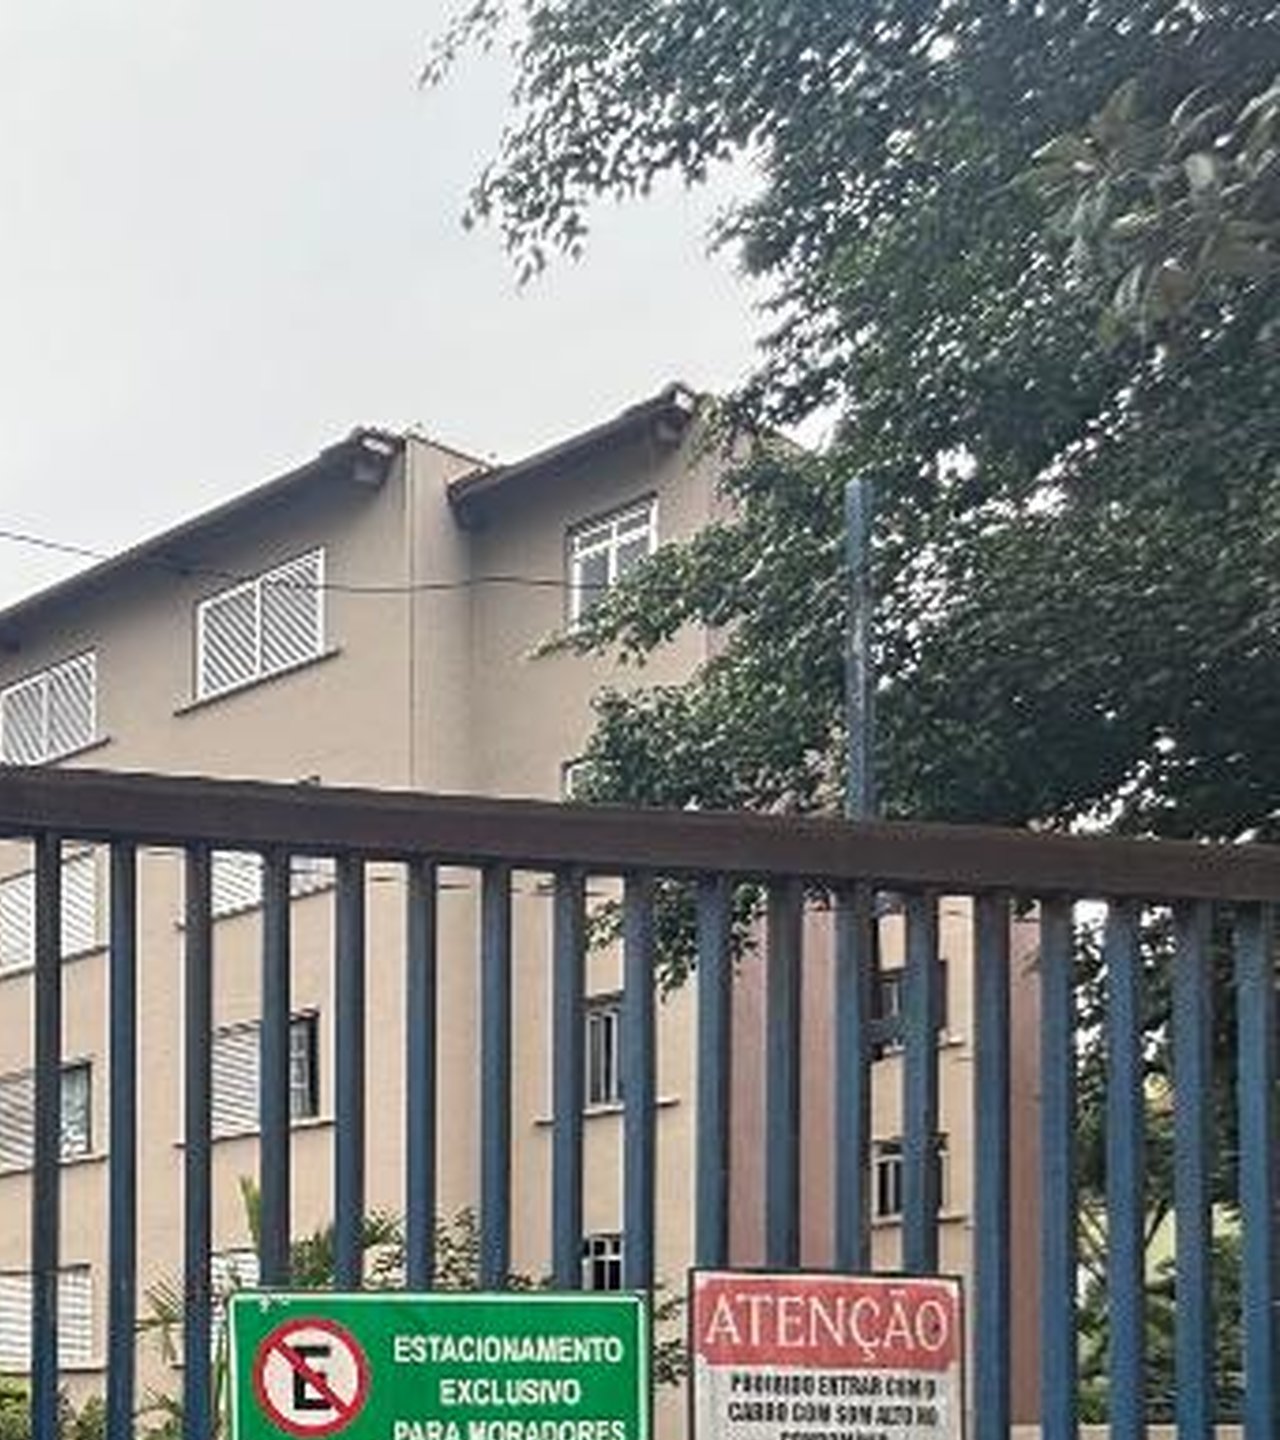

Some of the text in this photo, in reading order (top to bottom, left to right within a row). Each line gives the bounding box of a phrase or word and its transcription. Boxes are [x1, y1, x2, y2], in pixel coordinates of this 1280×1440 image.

[705, 1289, 948, 1361] ATENÇÃO
[393, 1335, 624, 1363] ESTACIONAMENTO
[440, 1378, 582, 1405] EXCLUSIVO
[818, 1375, 882, 1397] ENTRAR
[792, 1402, 831, 1423] COM
[836, 1404, 872, 1425] SOM
